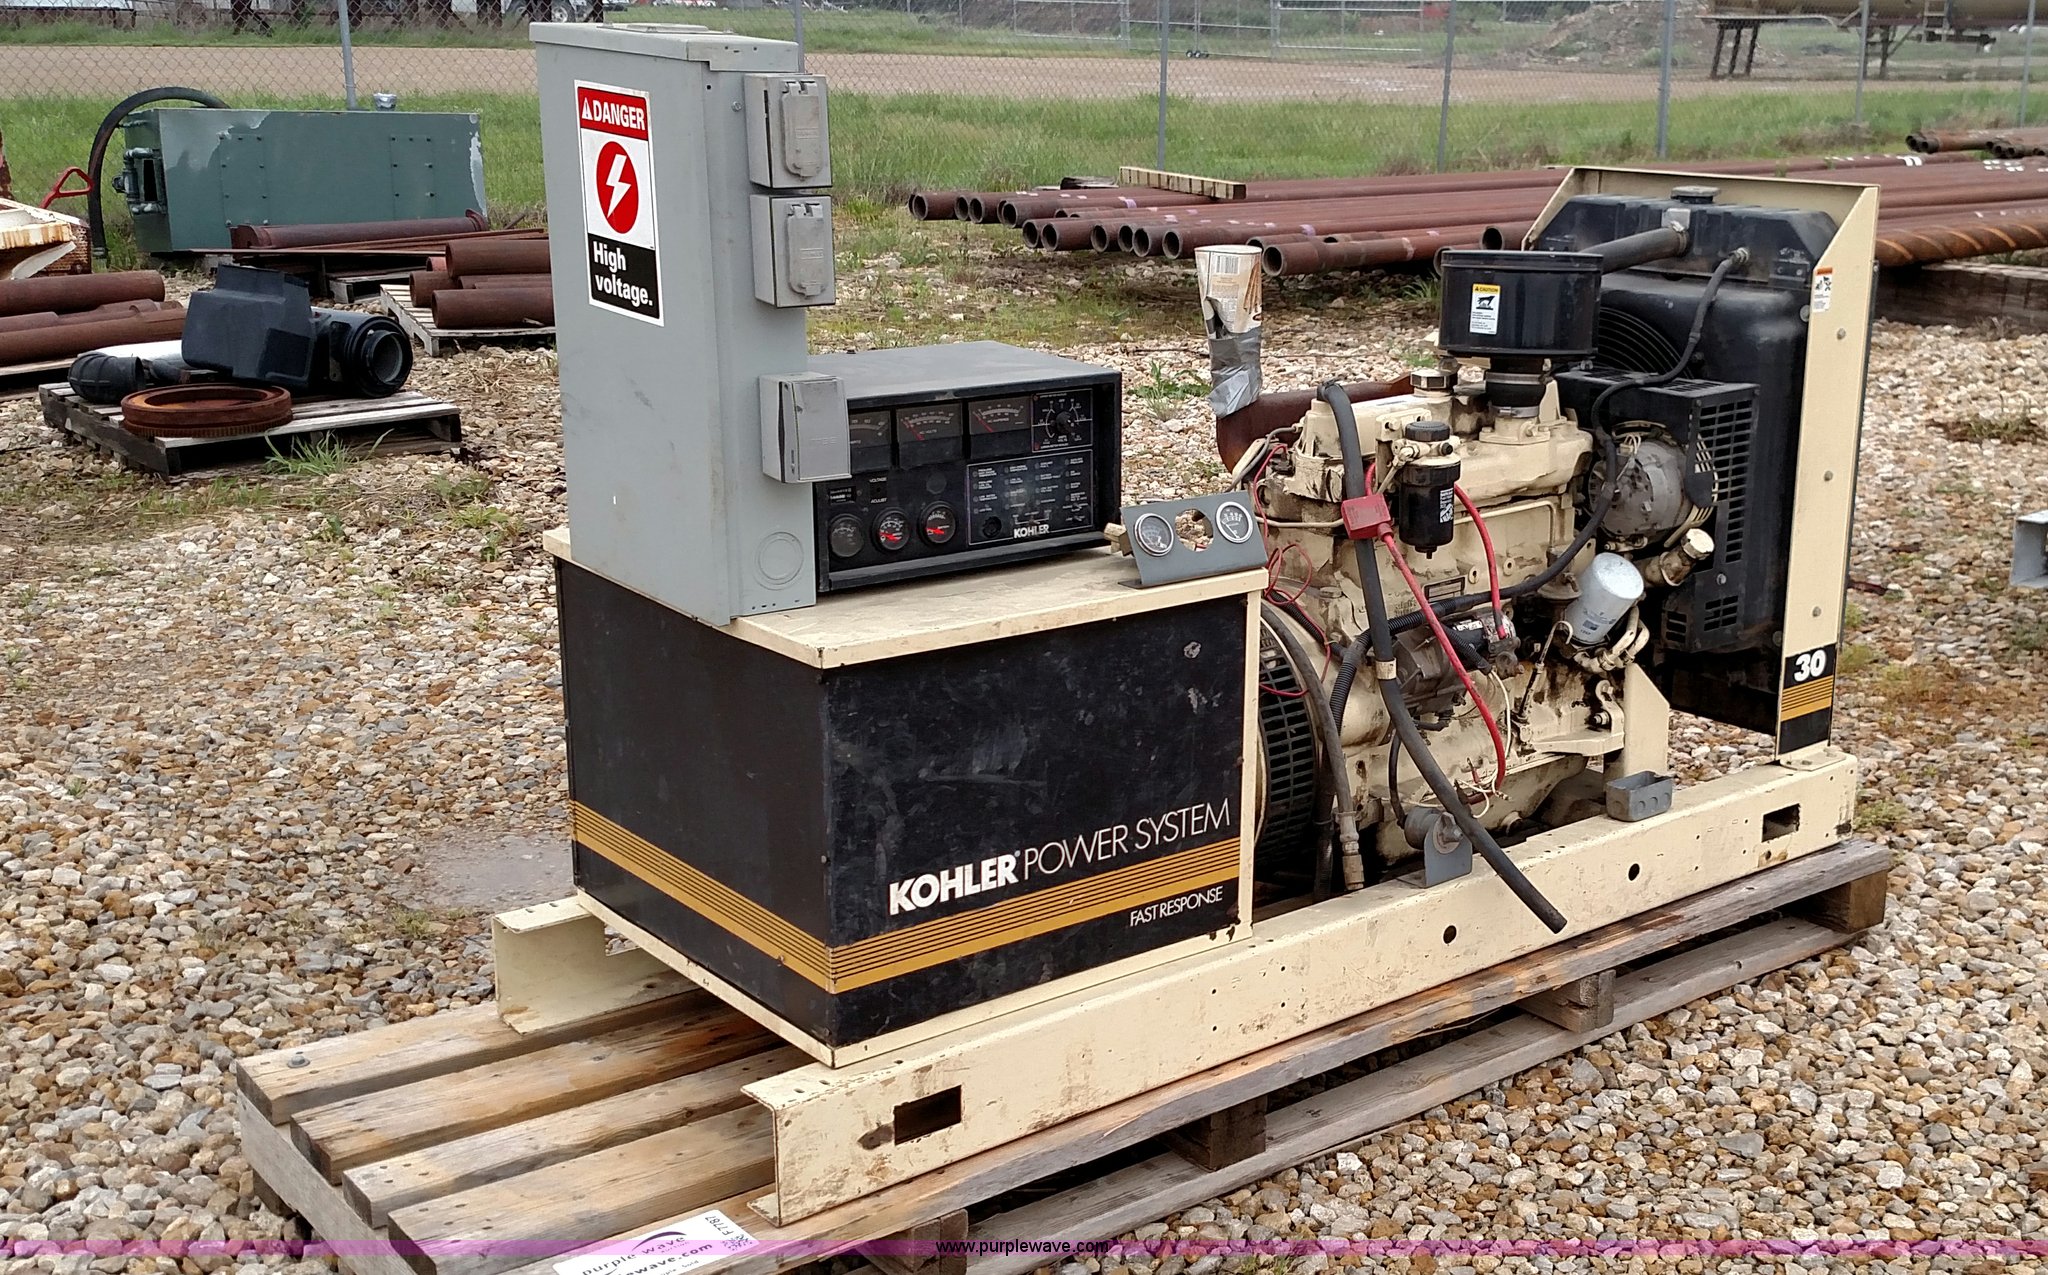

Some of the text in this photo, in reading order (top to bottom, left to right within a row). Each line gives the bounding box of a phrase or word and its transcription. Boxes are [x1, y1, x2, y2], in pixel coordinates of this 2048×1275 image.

[593, 100, 646, 131] DANGER
[593, 241, 626, 271] High
[595, 274, 653, 307] voltage.
[1014, 524, 1050, 539] KOHLER
[1793, 649, 1826, 682] 30
[1023, 824, 1129, 880] POWER
[1134, 798, 1231, 850] SYSTEM
[1129, 885, 1223, 927] FAST RESPONSE
[704, 1215, 734, 1236] F7787
[582, 1236, 685, 1275] purple wave
